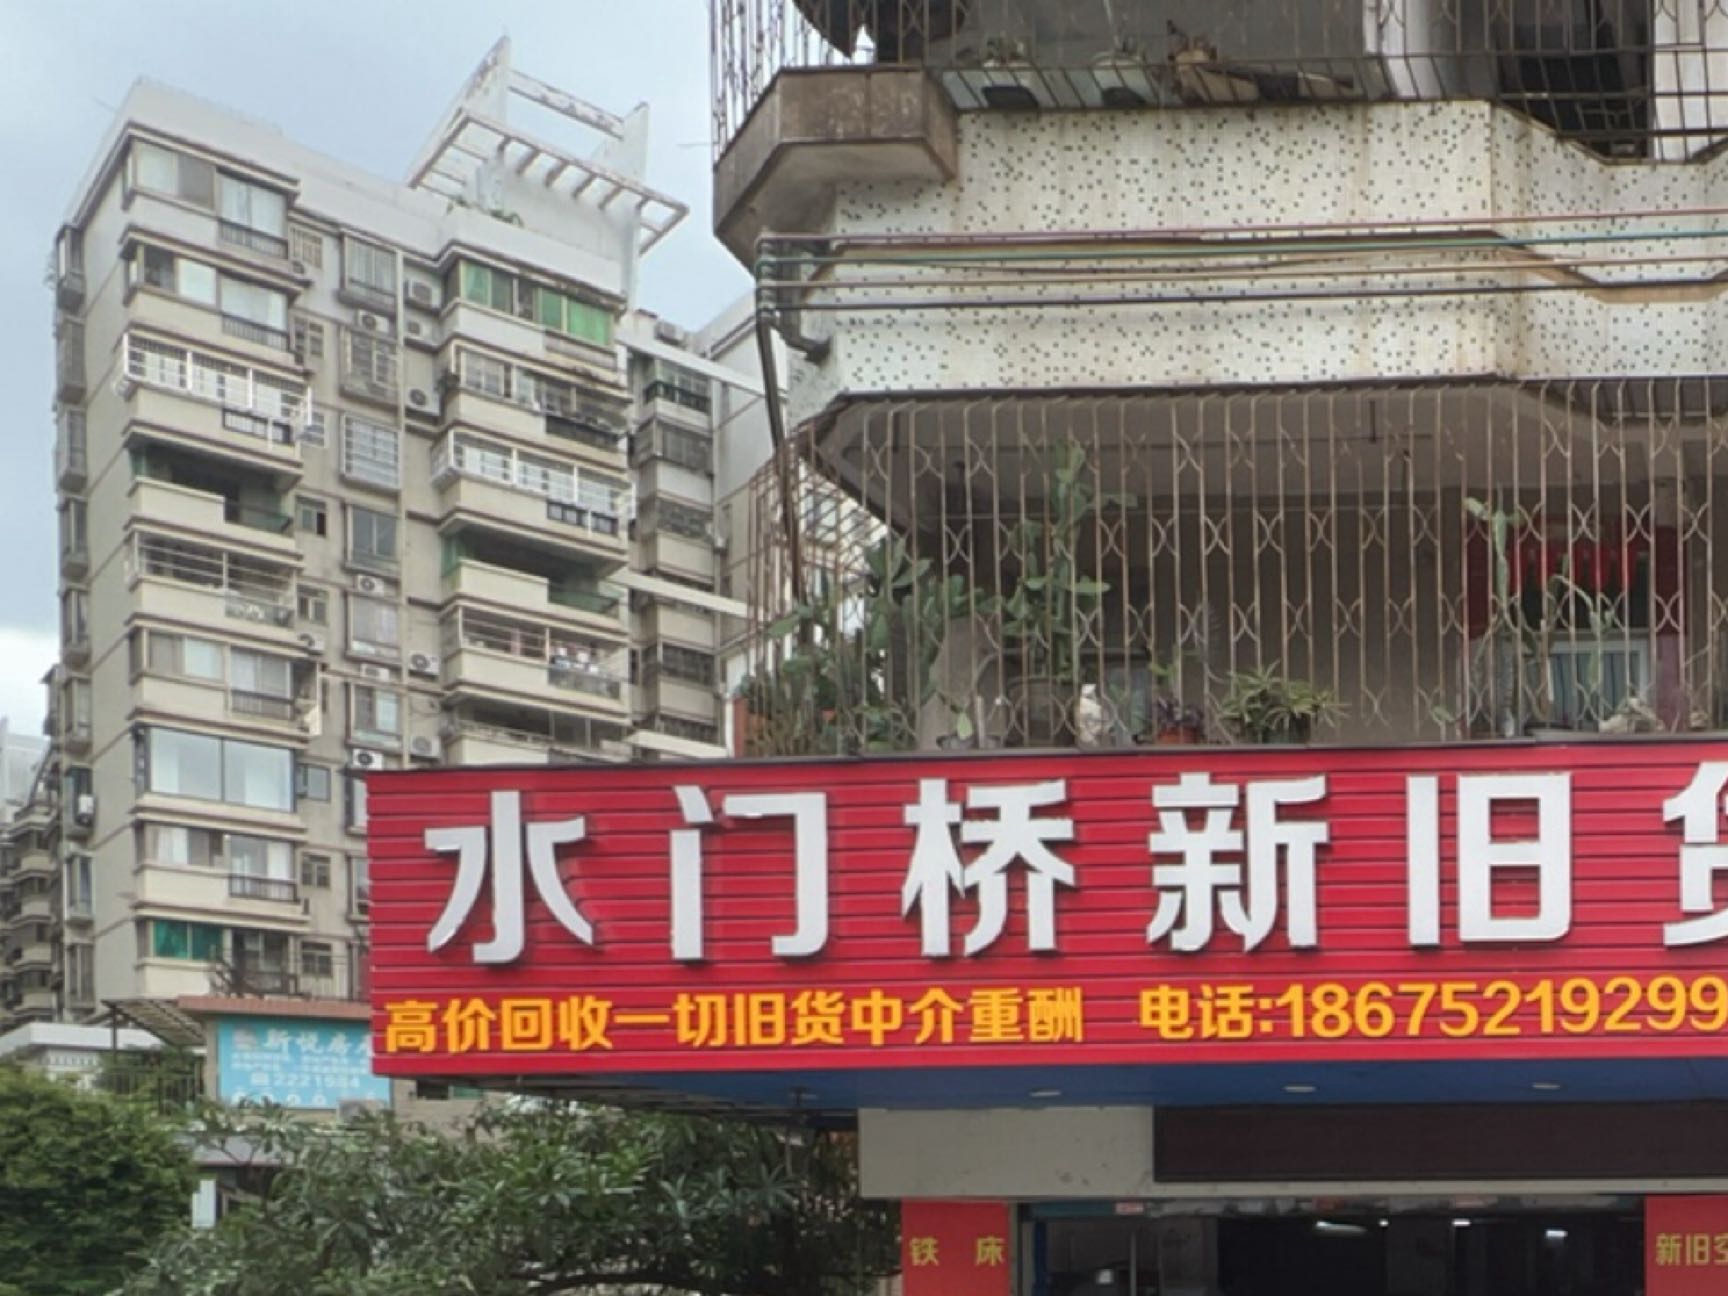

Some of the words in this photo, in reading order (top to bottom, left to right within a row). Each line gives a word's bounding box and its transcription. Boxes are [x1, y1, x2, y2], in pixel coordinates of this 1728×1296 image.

[384, 986, 1083, 1054] 高价回收一切旧货中介重酬
